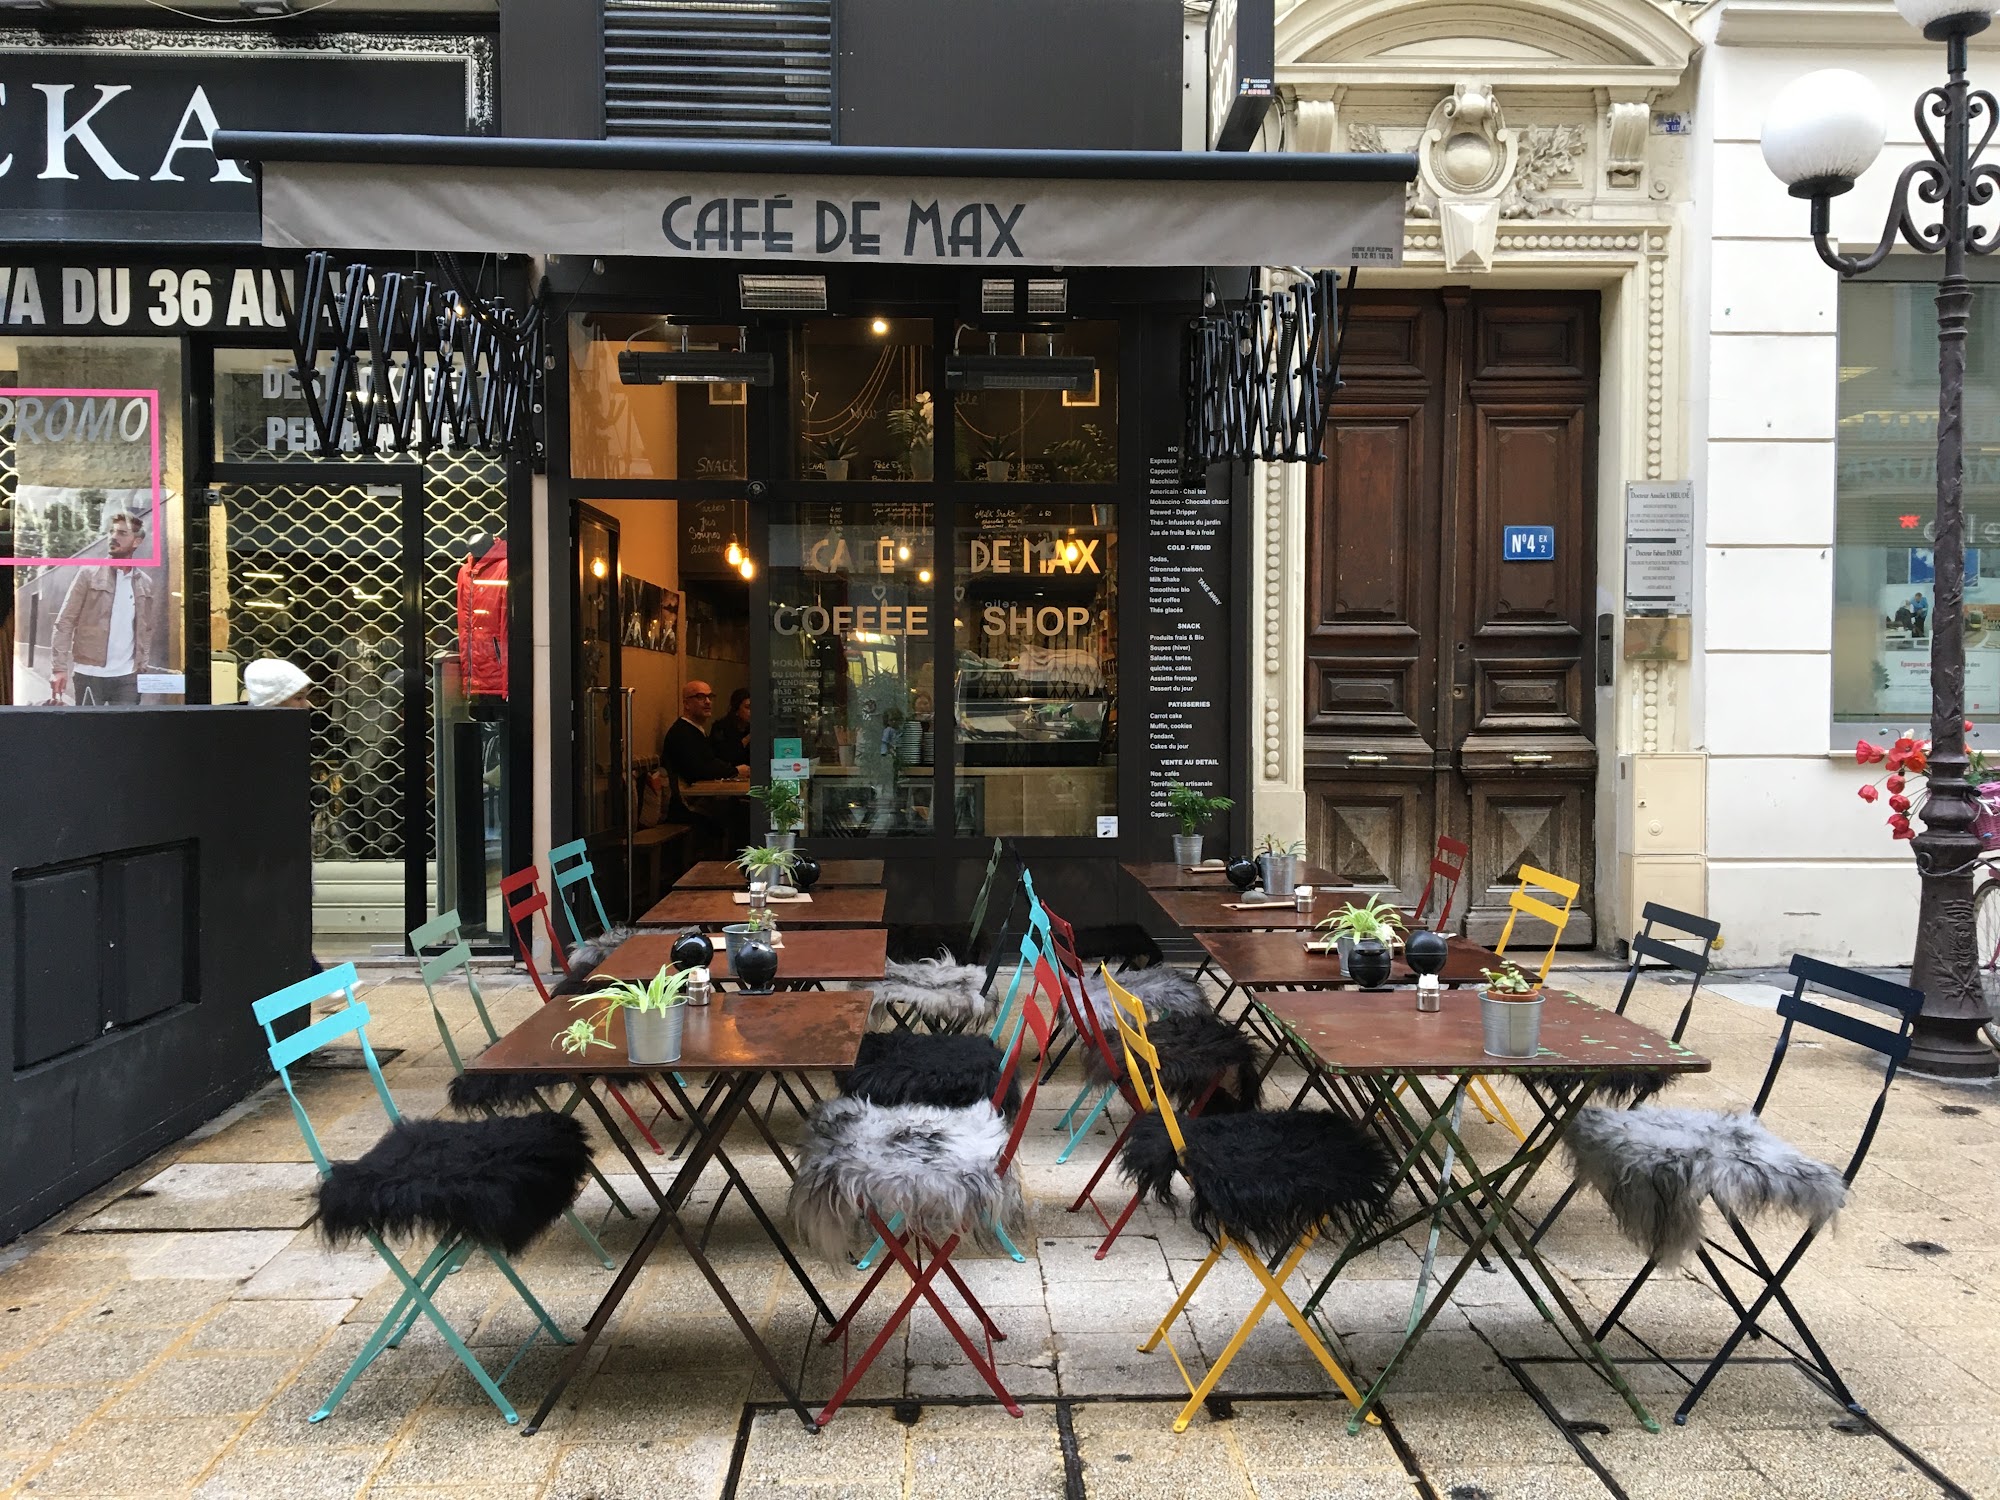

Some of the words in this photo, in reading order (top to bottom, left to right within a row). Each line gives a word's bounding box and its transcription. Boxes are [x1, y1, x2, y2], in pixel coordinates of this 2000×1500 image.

[0, 83, 252, 183] KA
[662, 194, 794, 252] CAFÉ
[816, 200, 881, 255] DE
[904, 199, 1025, 259] MAX
[62, 268, 131, 327] DU
[148, 268, 213, 328] 36
[226, 268, 295, 328] AU
[1539, 534, 1548, 543] EX
[1541, 545, 1546, 553] 2
[970, 539, 1011, 574] DE
[1023, 539, 1101, 574] MAX
[1198, 577, 1211, 593] TAKE
[1207, 591, 1222, 606] AWAY
[774, 605, 929, 636] COFFEE
[983, 605, 1090, 636] SHOP
[772, 658, 821, 668] HORAIRES
